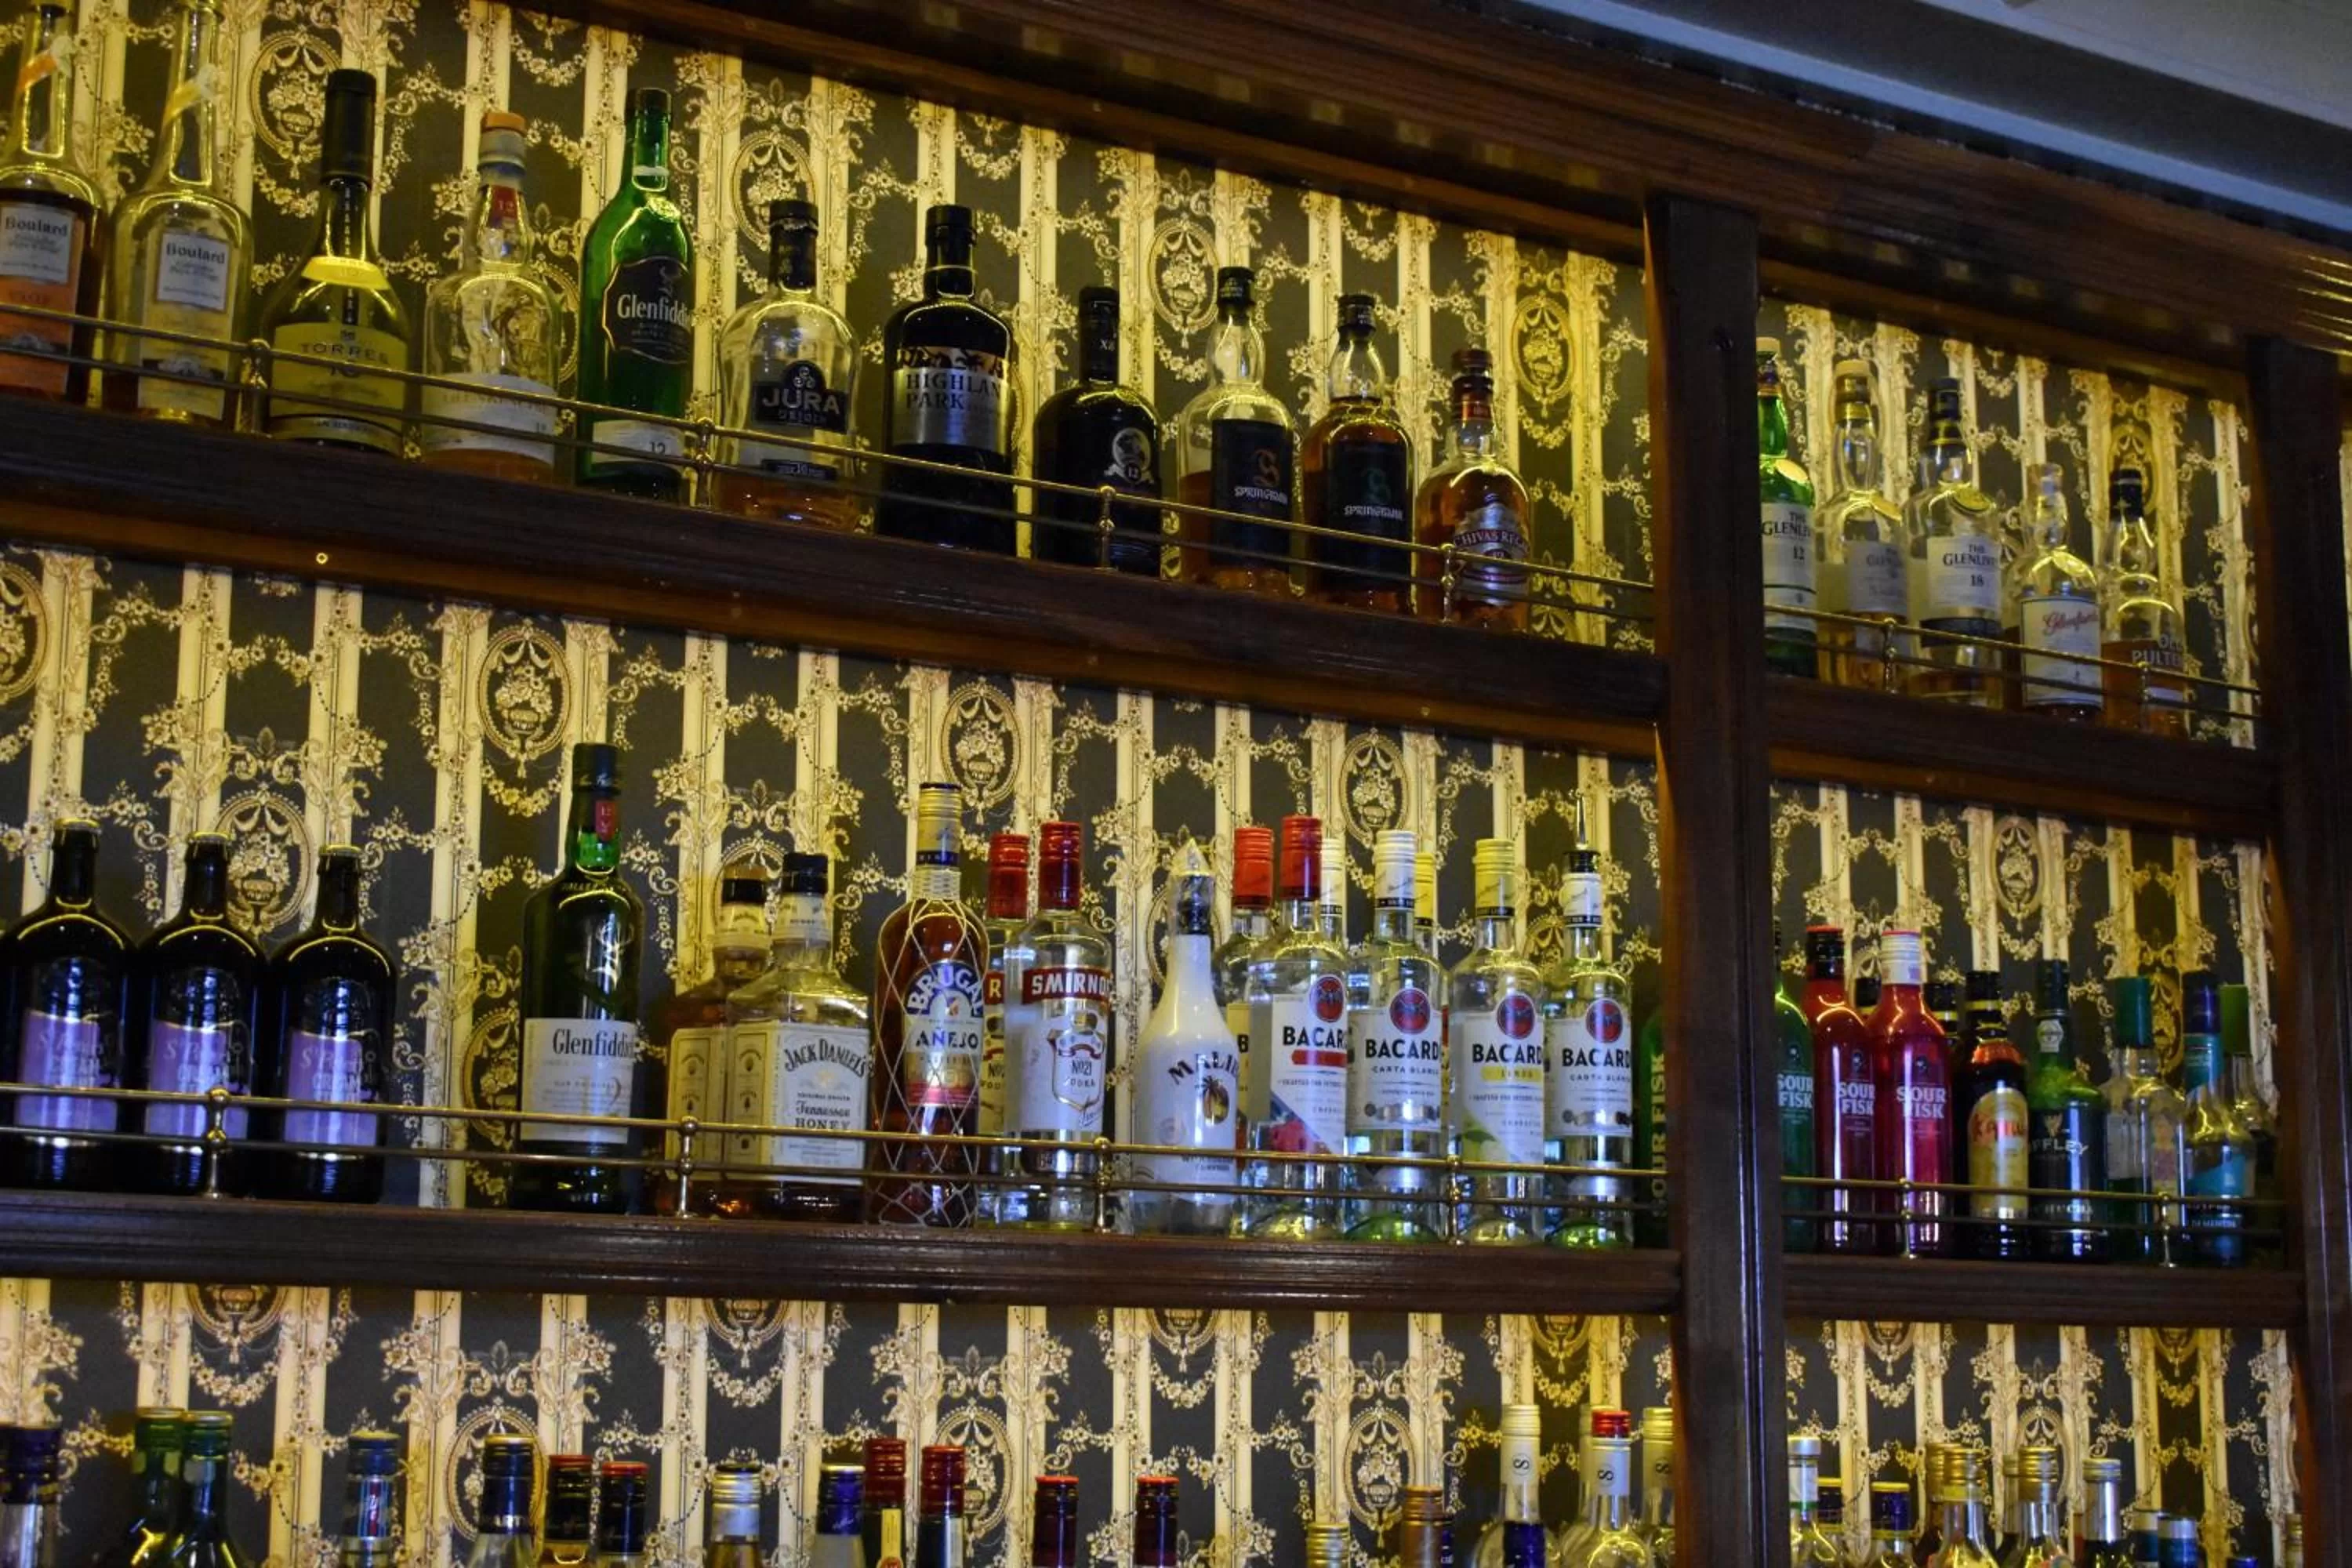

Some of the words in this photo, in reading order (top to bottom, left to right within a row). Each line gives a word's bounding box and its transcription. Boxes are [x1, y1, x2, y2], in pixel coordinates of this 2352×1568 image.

[5, 216, 68, 237] Boulard
[165, 242, 225, 265] Boulard
[617, 293, 690, 328] Glenfiddi
[906, 374, 1001, 400] HIGHLAN
[761, 389, 840, 416] JURA
[907, 393, 965, 410] PARK
[1454, 530, 1497, 549] CHIVAS
[1792, 546, 1806, 561] 12
[553, 1028, 634, 1058] Glenfiddi
[1283, 1026, 1345, 1049] BACAR
[785, 1044, 816, 1072] JACK
[1365, 1039, 1439, 1061] BACARD
[1472, 1044, 1542, 1065] BACARD
[1562, 1048, 1631, 1069] BACARD
[1168, 1051, 1238, 1085] MALIB
[1777, 1091, 1813, 1109] FISK
[1896, 1085, 1947, 1103] SOUR
[1841, 1098, 1875, 1117] FISK
[795, 1116, 851, 1130] HONEY
